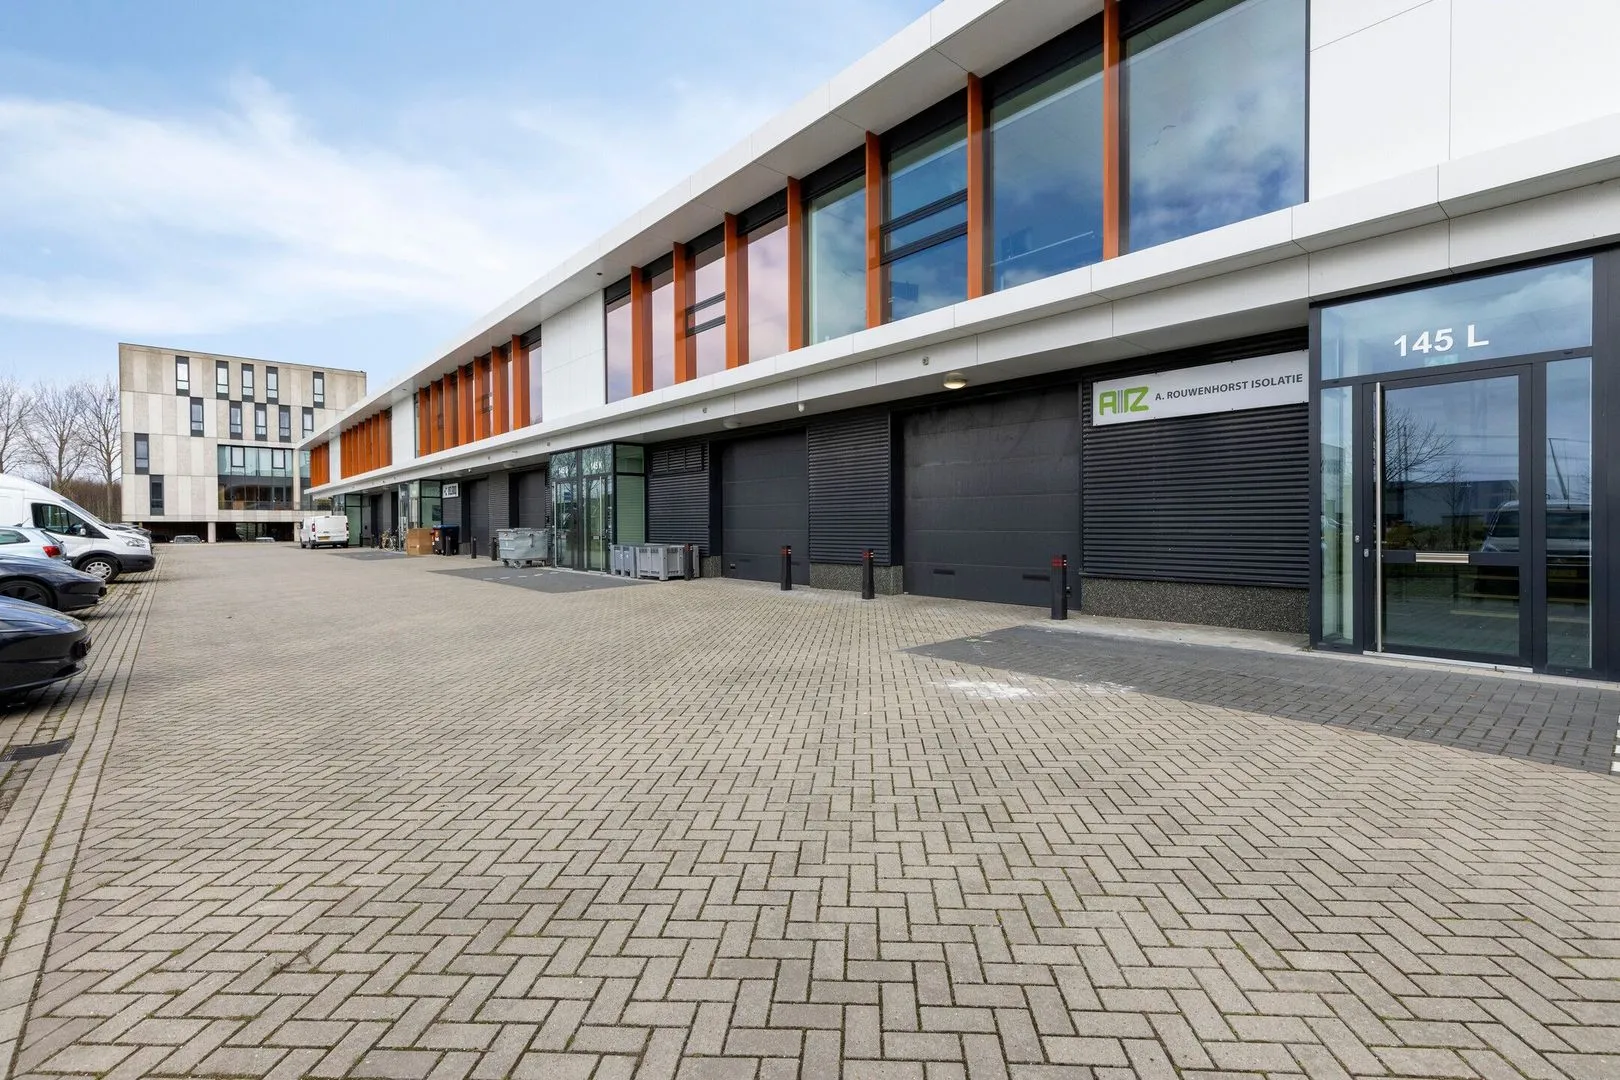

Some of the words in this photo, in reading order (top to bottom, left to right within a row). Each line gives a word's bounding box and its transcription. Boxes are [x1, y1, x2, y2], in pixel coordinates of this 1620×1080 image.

[1393, 327, 1454, 357] 145
[1467, 324, 1490, 348] L
[1155, 392, 1165, 401] A.
[1167, 380, 1249, 400] ROUWENHORST
[1251, 373, 1304, 389] ISOLATIE
